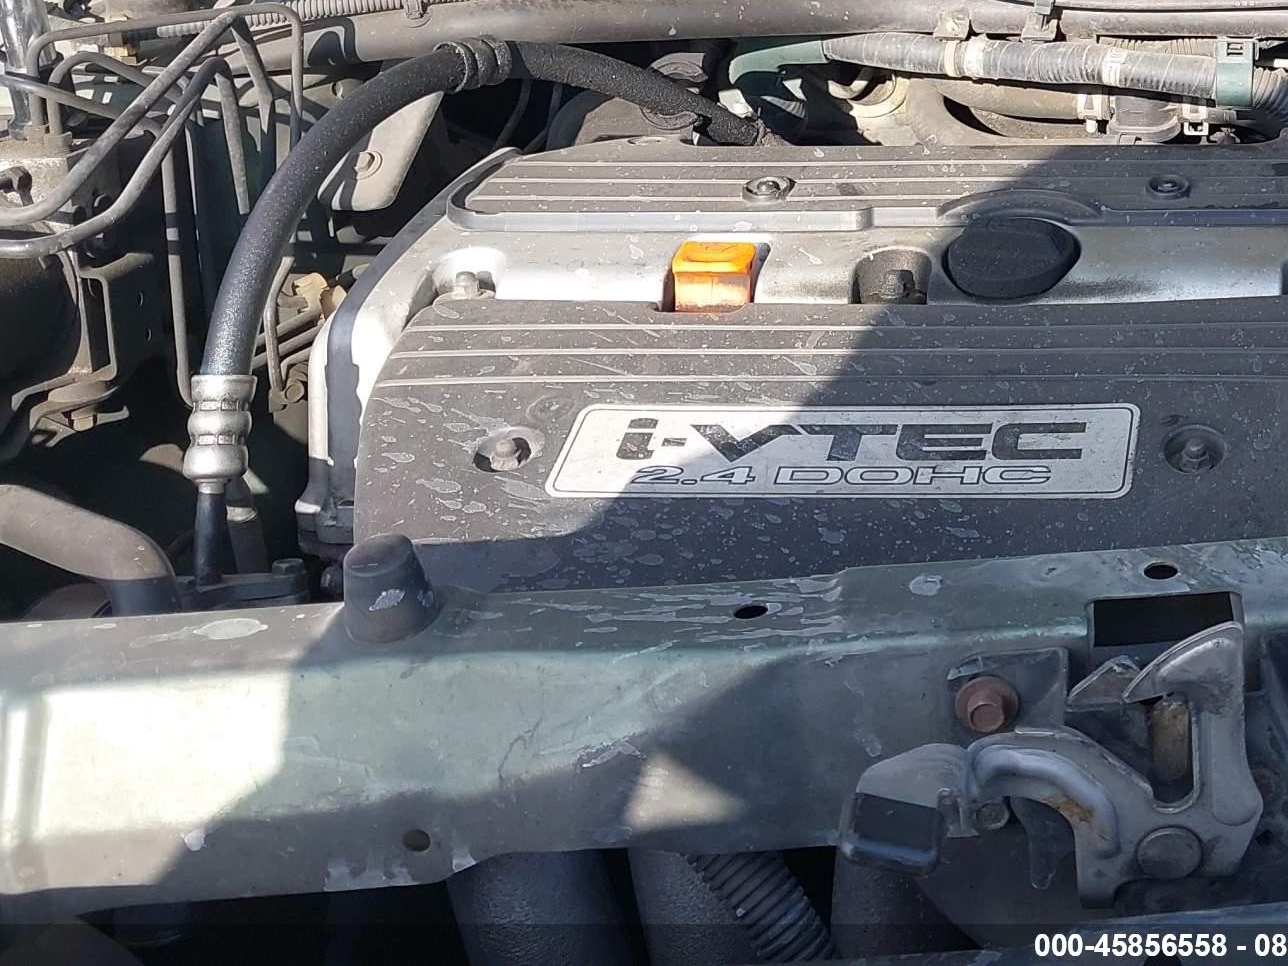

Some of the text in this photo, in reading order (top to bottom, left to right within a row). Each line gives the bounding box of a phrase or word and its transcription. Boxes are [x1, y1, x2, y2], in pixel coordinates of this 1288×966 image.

[615, 417, 1088, 463] i-VTEC
[630, 465, 1052, 485] 2.4 DOHC
